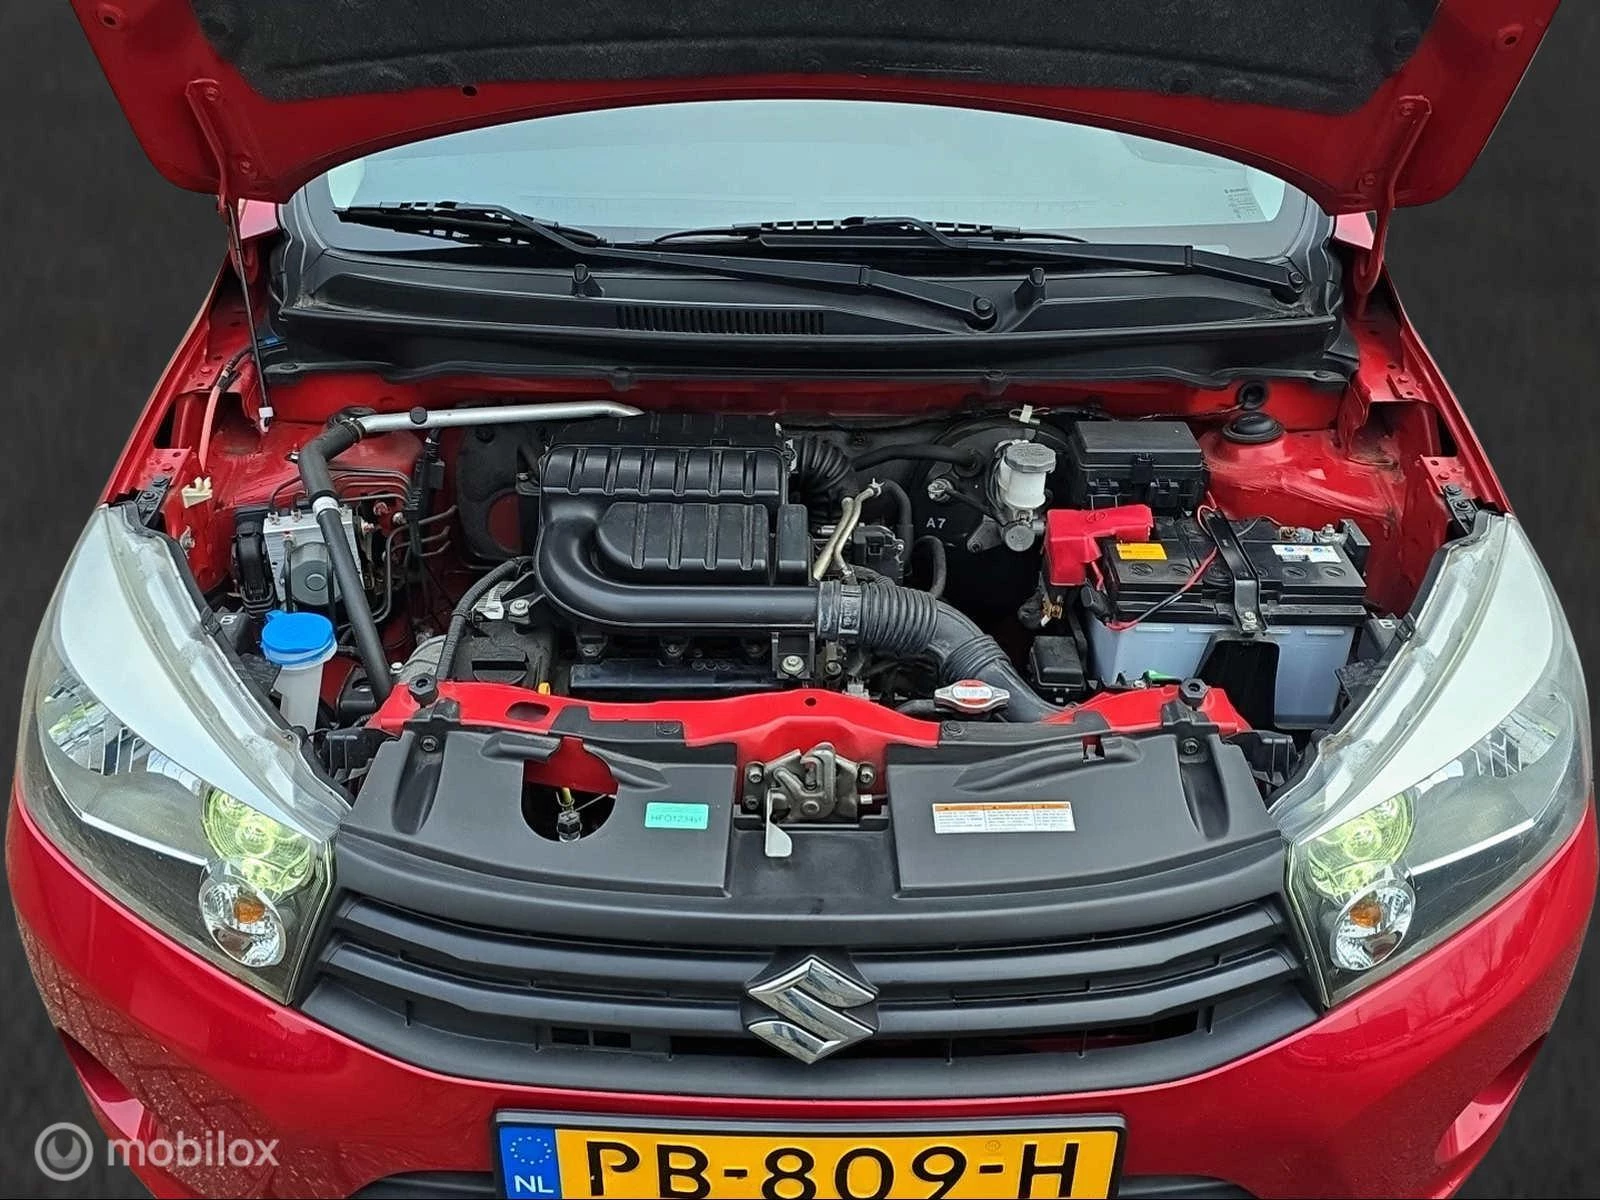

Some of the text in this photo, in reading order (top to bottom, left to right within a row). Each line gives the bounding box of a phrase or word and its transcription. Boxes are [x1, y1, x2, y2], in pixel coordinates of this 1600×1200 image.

[926, 517, 946, 528] A7
[586, 1140, 1080, 1199] PB-809-H
[514, 1174, 554, 1194] NL
